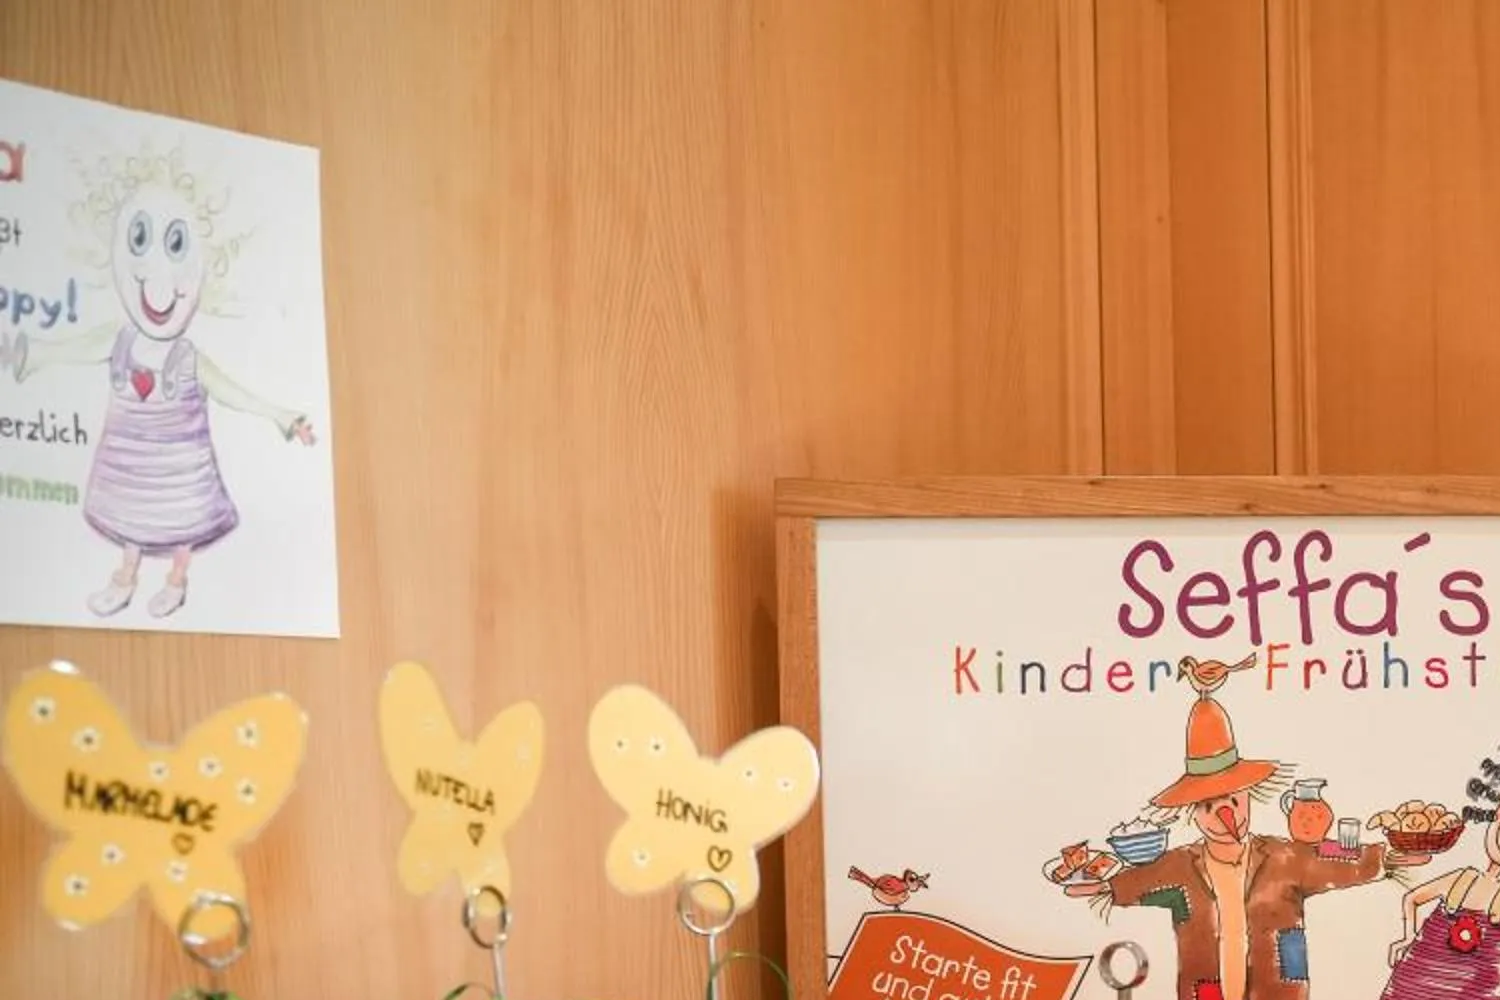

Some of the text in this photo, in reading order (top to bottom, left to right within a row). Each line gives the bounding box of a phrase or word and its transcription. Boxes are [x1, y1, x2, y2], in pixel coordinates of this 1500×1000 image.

[0, 472, 79, 505] mmen
[954, 646, 1172, 695] Kinder
[415, 767, 496, 816] NUTELLA
[890, 934, 991, 991] Starte
